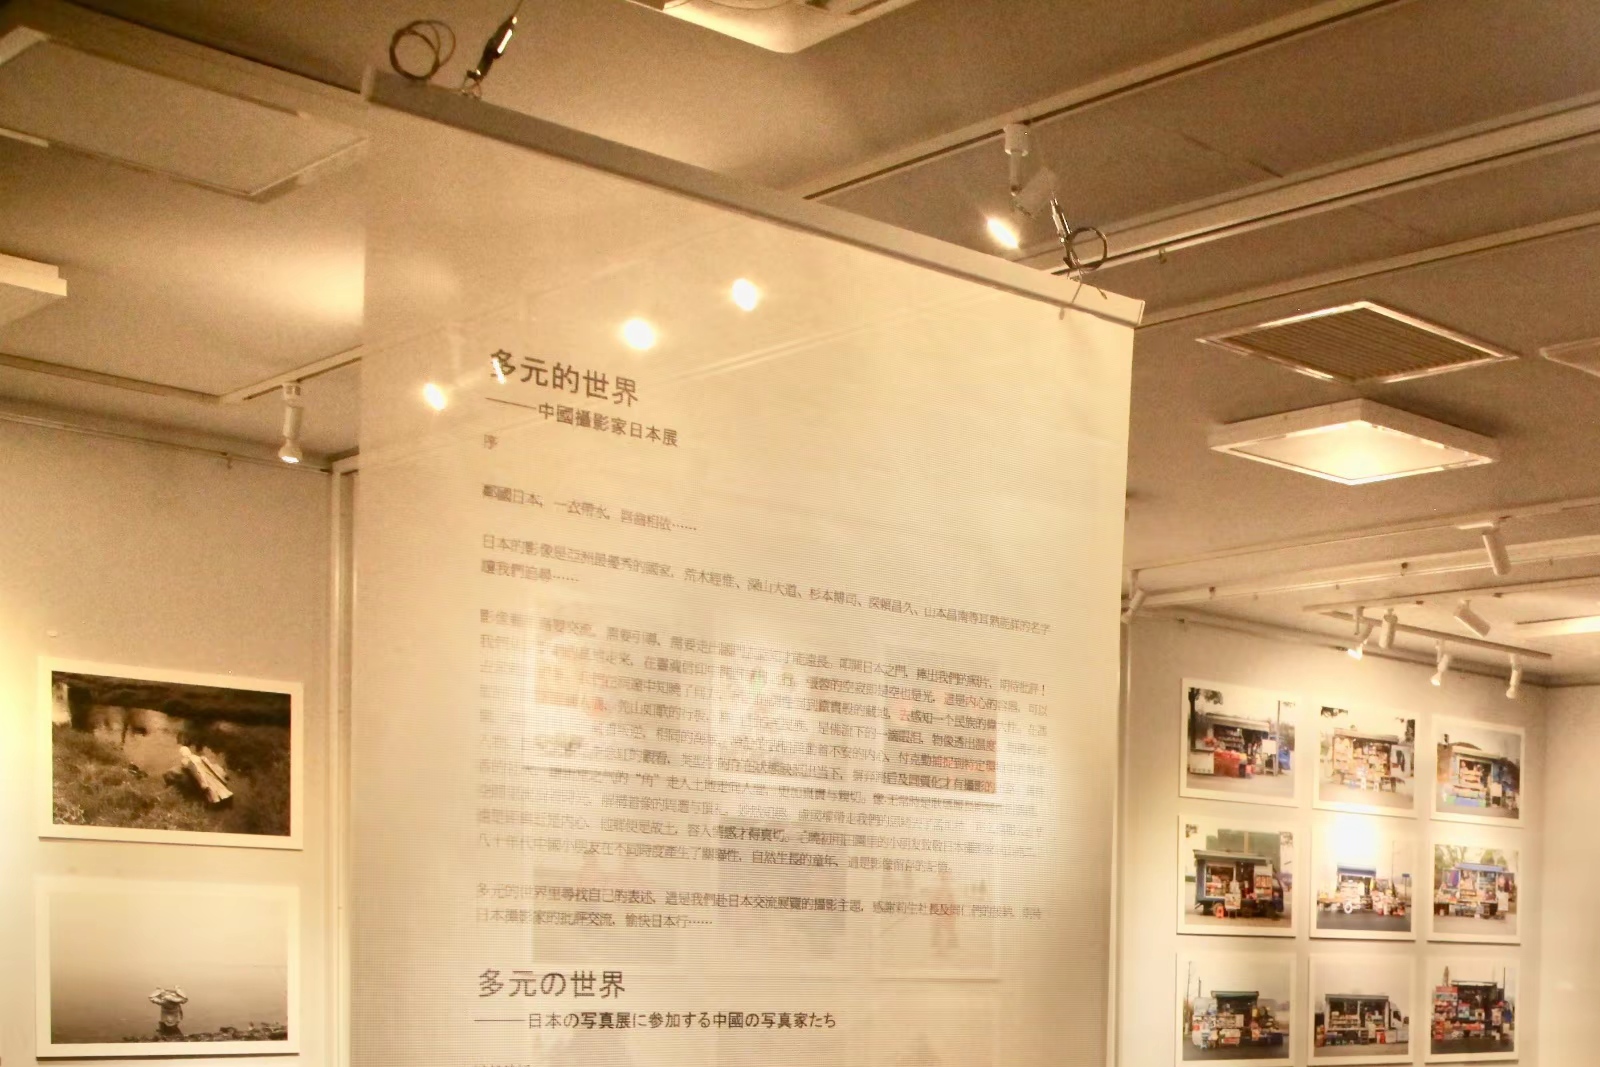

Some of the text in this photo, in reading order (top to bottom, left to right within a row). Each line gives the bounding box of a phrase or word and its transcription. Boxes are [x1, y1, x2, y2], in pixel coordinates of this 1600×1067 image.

[489, 349, 640, 408] 多元的世界
[478, 968, 625, 999] 多元の世界
